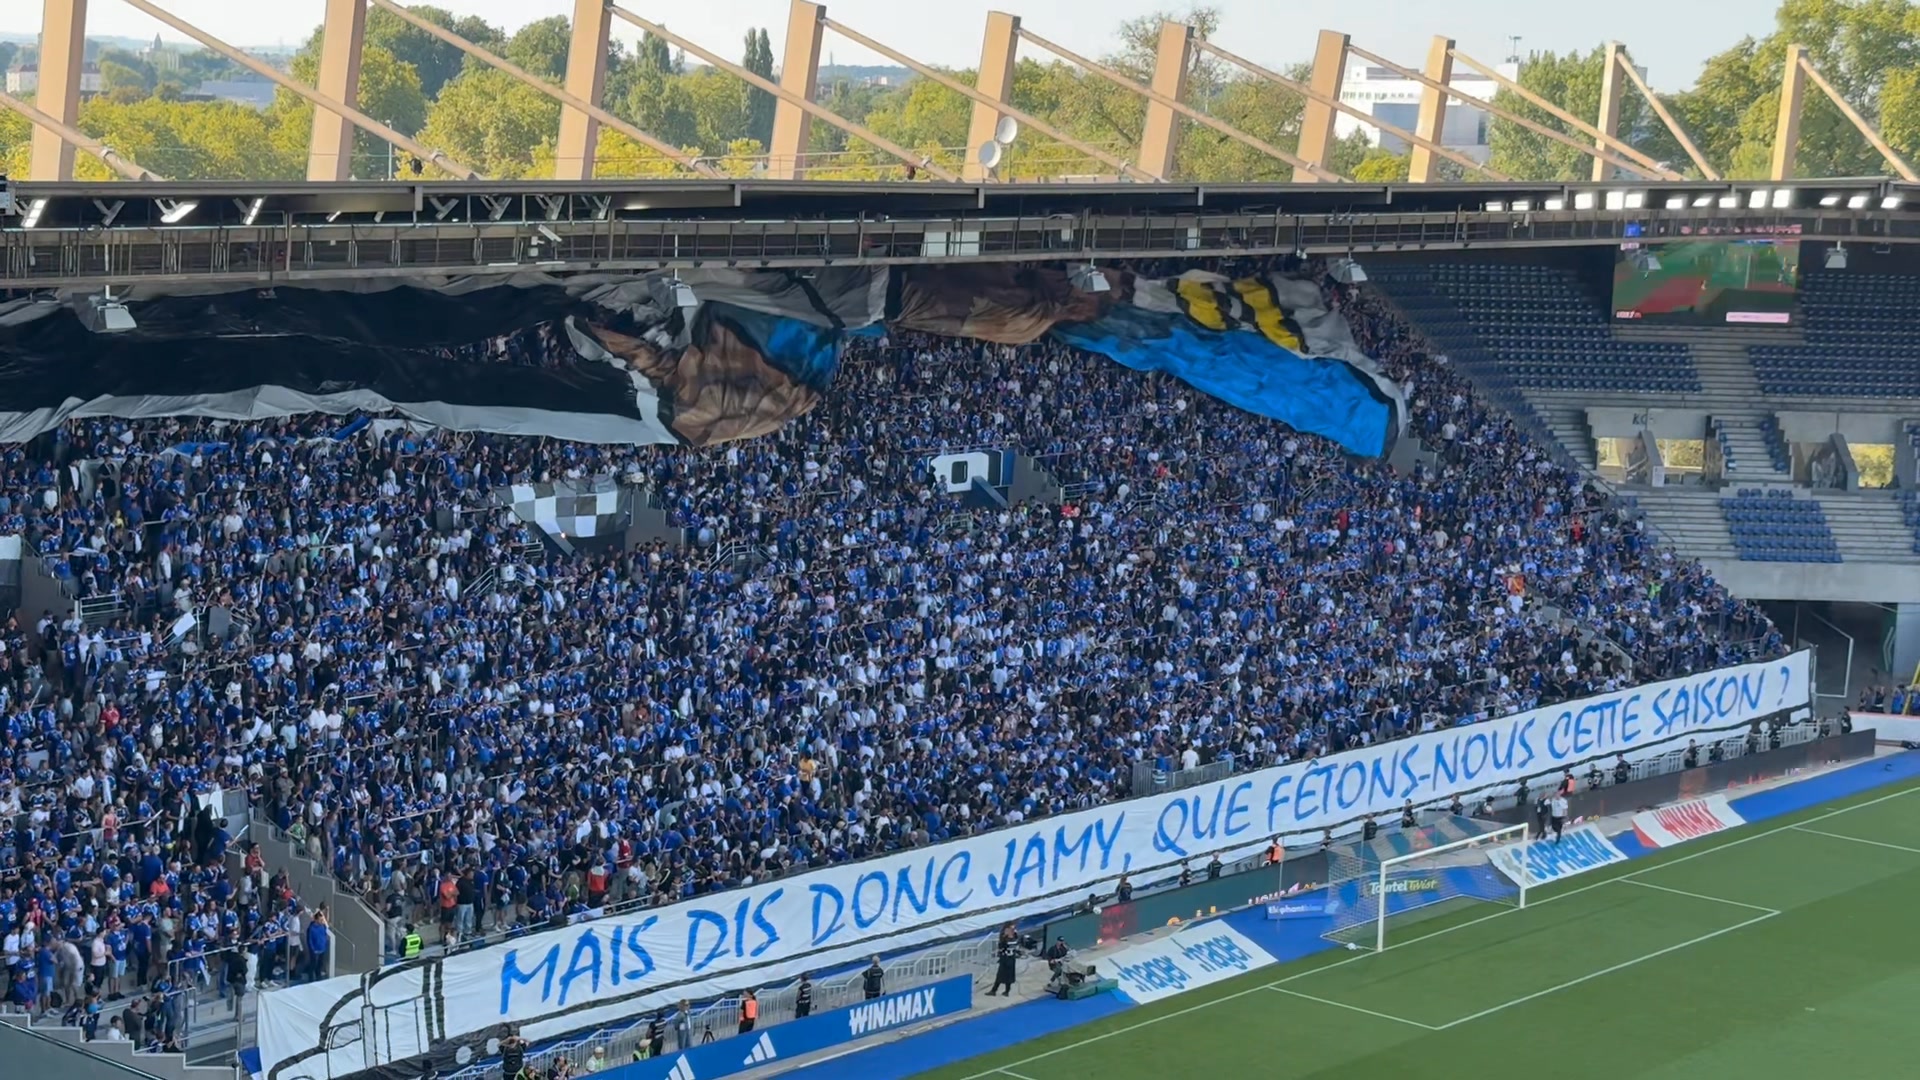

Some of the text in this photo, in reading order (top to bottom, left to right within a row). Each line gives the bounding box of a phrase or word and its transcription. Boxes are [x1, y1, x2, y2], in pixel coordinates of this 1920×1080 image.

[499, 665, 1790, 1015] MAIS DIS DONC JAMY, QUE FÊTONS-NOUS CETTE SAISON ?
[1511, 828, 1619, 880] SOPREMA
[848, 987, 936, 1036] WINAMAX
